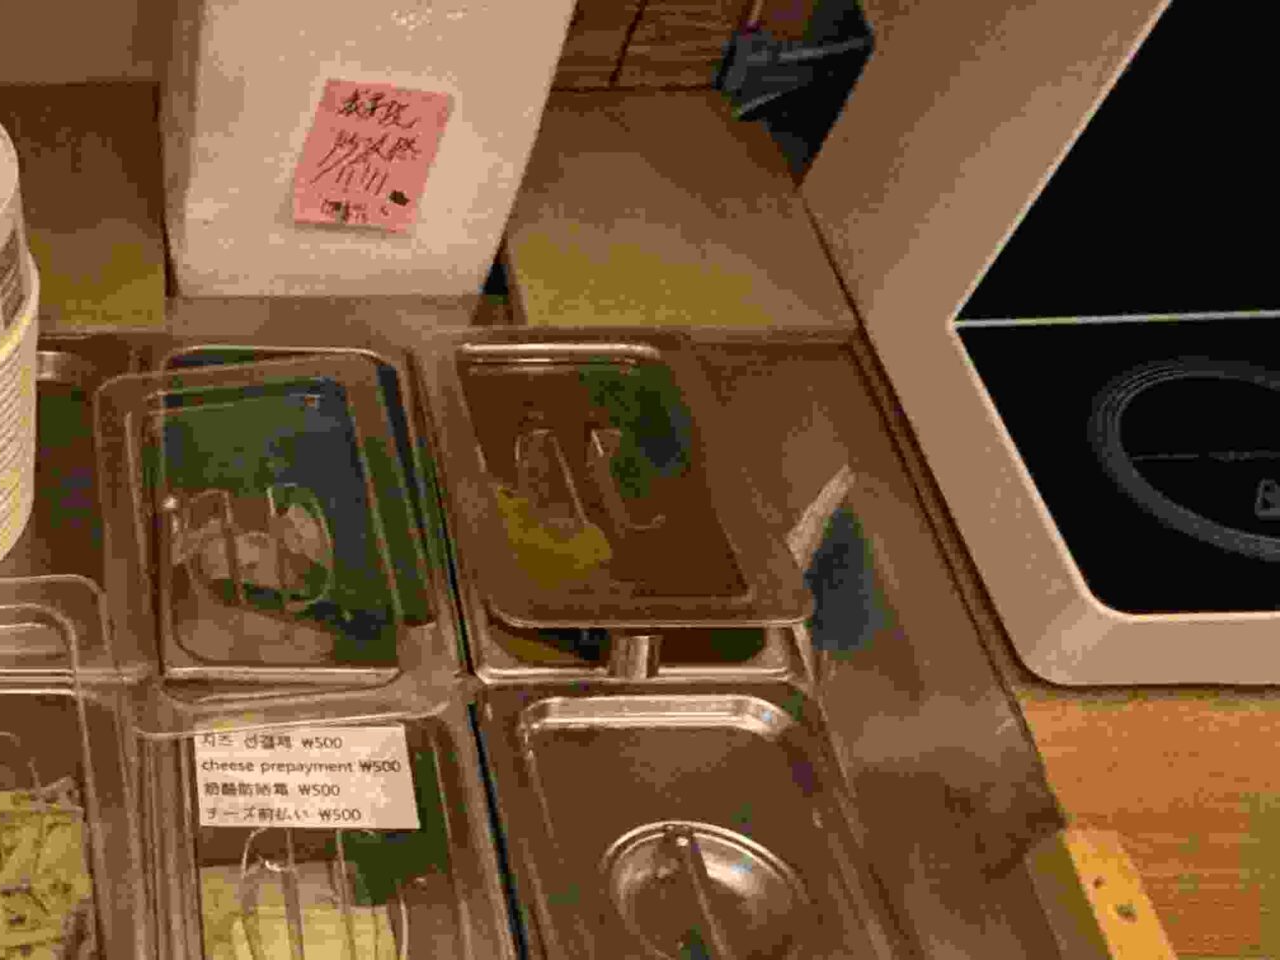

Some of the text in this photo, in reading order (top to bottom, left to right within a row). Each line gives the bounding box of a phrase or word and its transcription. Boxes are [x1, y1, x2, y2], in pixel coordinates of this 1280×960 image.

[243, 733, 293, 751] 선결제
[300, 736, 343, 750] ₩500
[200, 757, 402, 777] cheese prepayment ₩500
[297, 783, 341, 797] ₩500
[318, 807, 362, 822] ₩500
